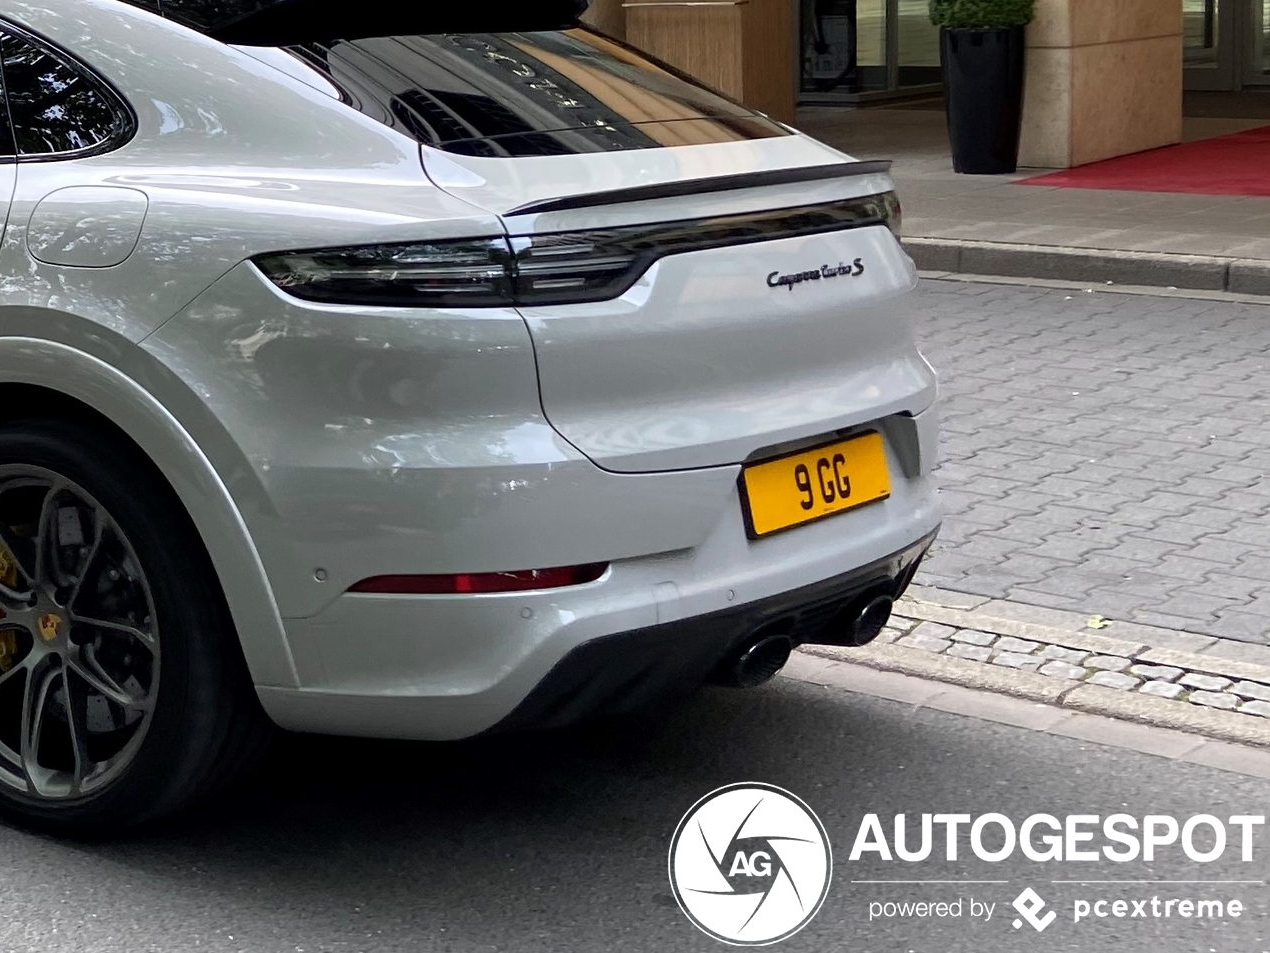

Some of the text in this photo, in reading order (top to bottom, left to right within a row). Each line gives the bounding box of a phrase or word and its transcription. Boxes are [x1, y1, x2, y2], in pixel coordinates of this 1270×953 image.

[766, 271, 821, 291] Cayenne
[851, 257, 865, 277] S
[794, 453, 851, 511] 9 GG
